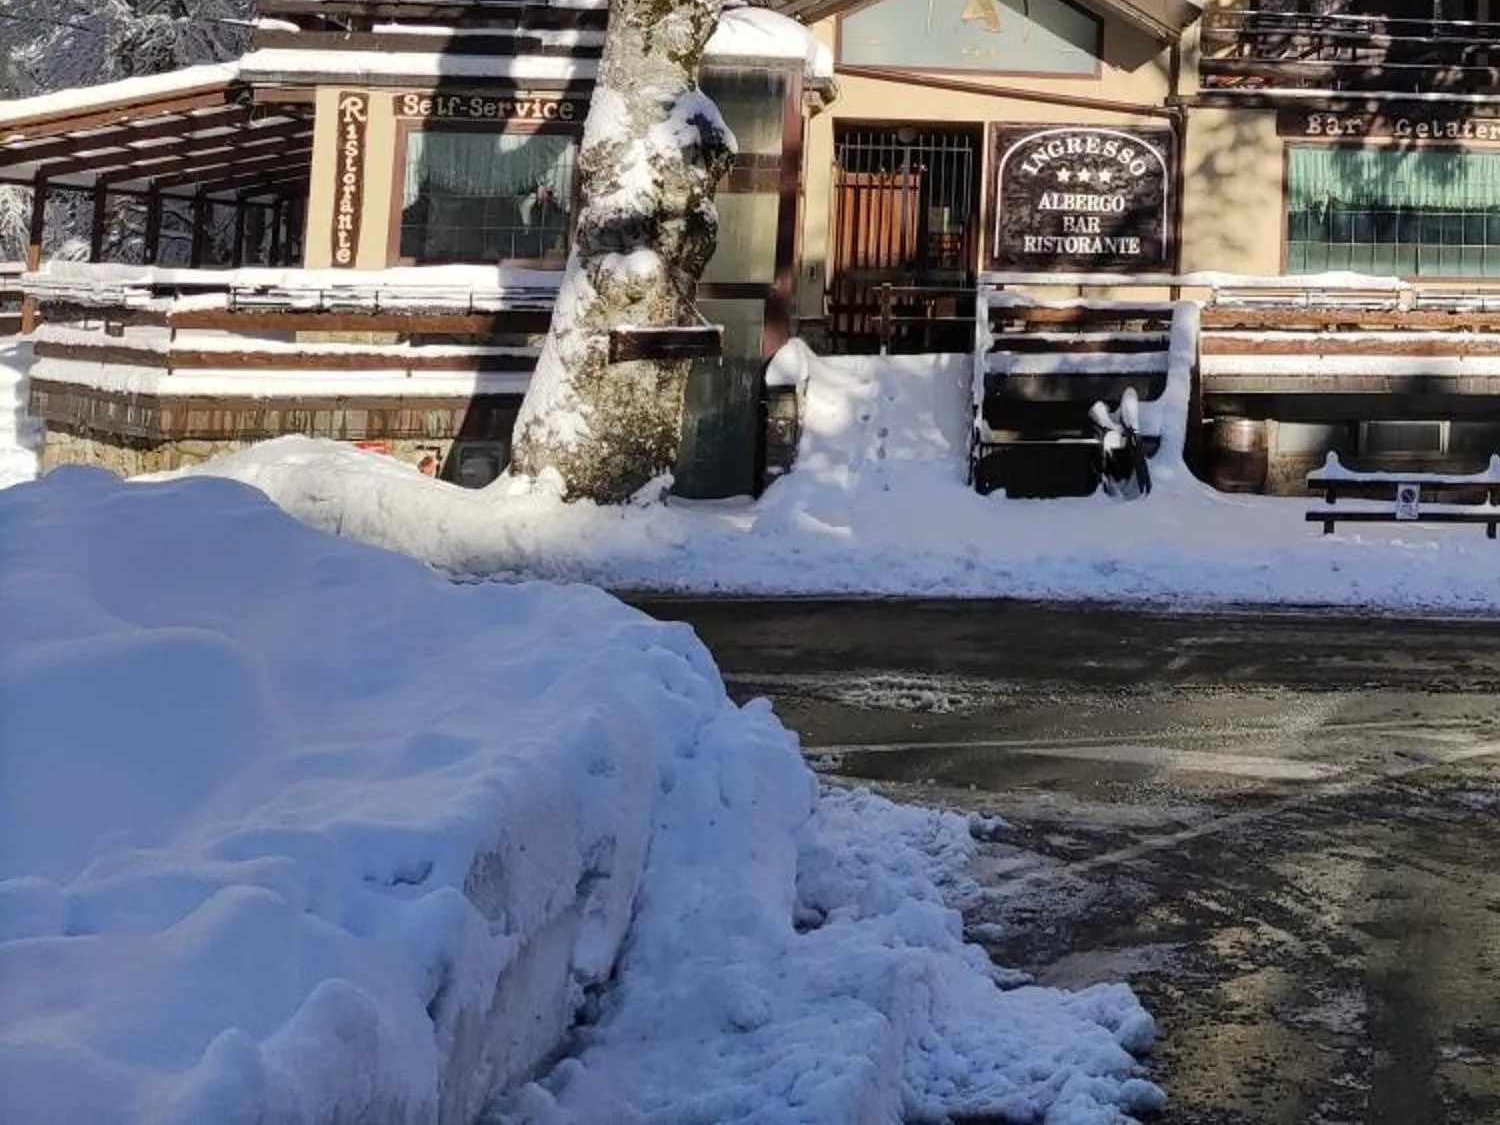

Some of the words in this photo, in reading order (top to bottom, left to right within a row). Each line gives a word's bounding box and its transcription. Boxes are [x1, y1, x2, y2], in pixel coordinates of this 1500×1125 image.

[403, 94, 574, 119] Self-Service
[1305, 114, 1363, 135] Bar
[1022, 137, 1147, 176] INGRESSO
[335, 96, 367, 264] Ristorante
[1037, 192, 1125, 212] ALBERGO
[1063, 216, 1101, 234] BAR
[1023, 235, 1141, 254] RISTORANTE
